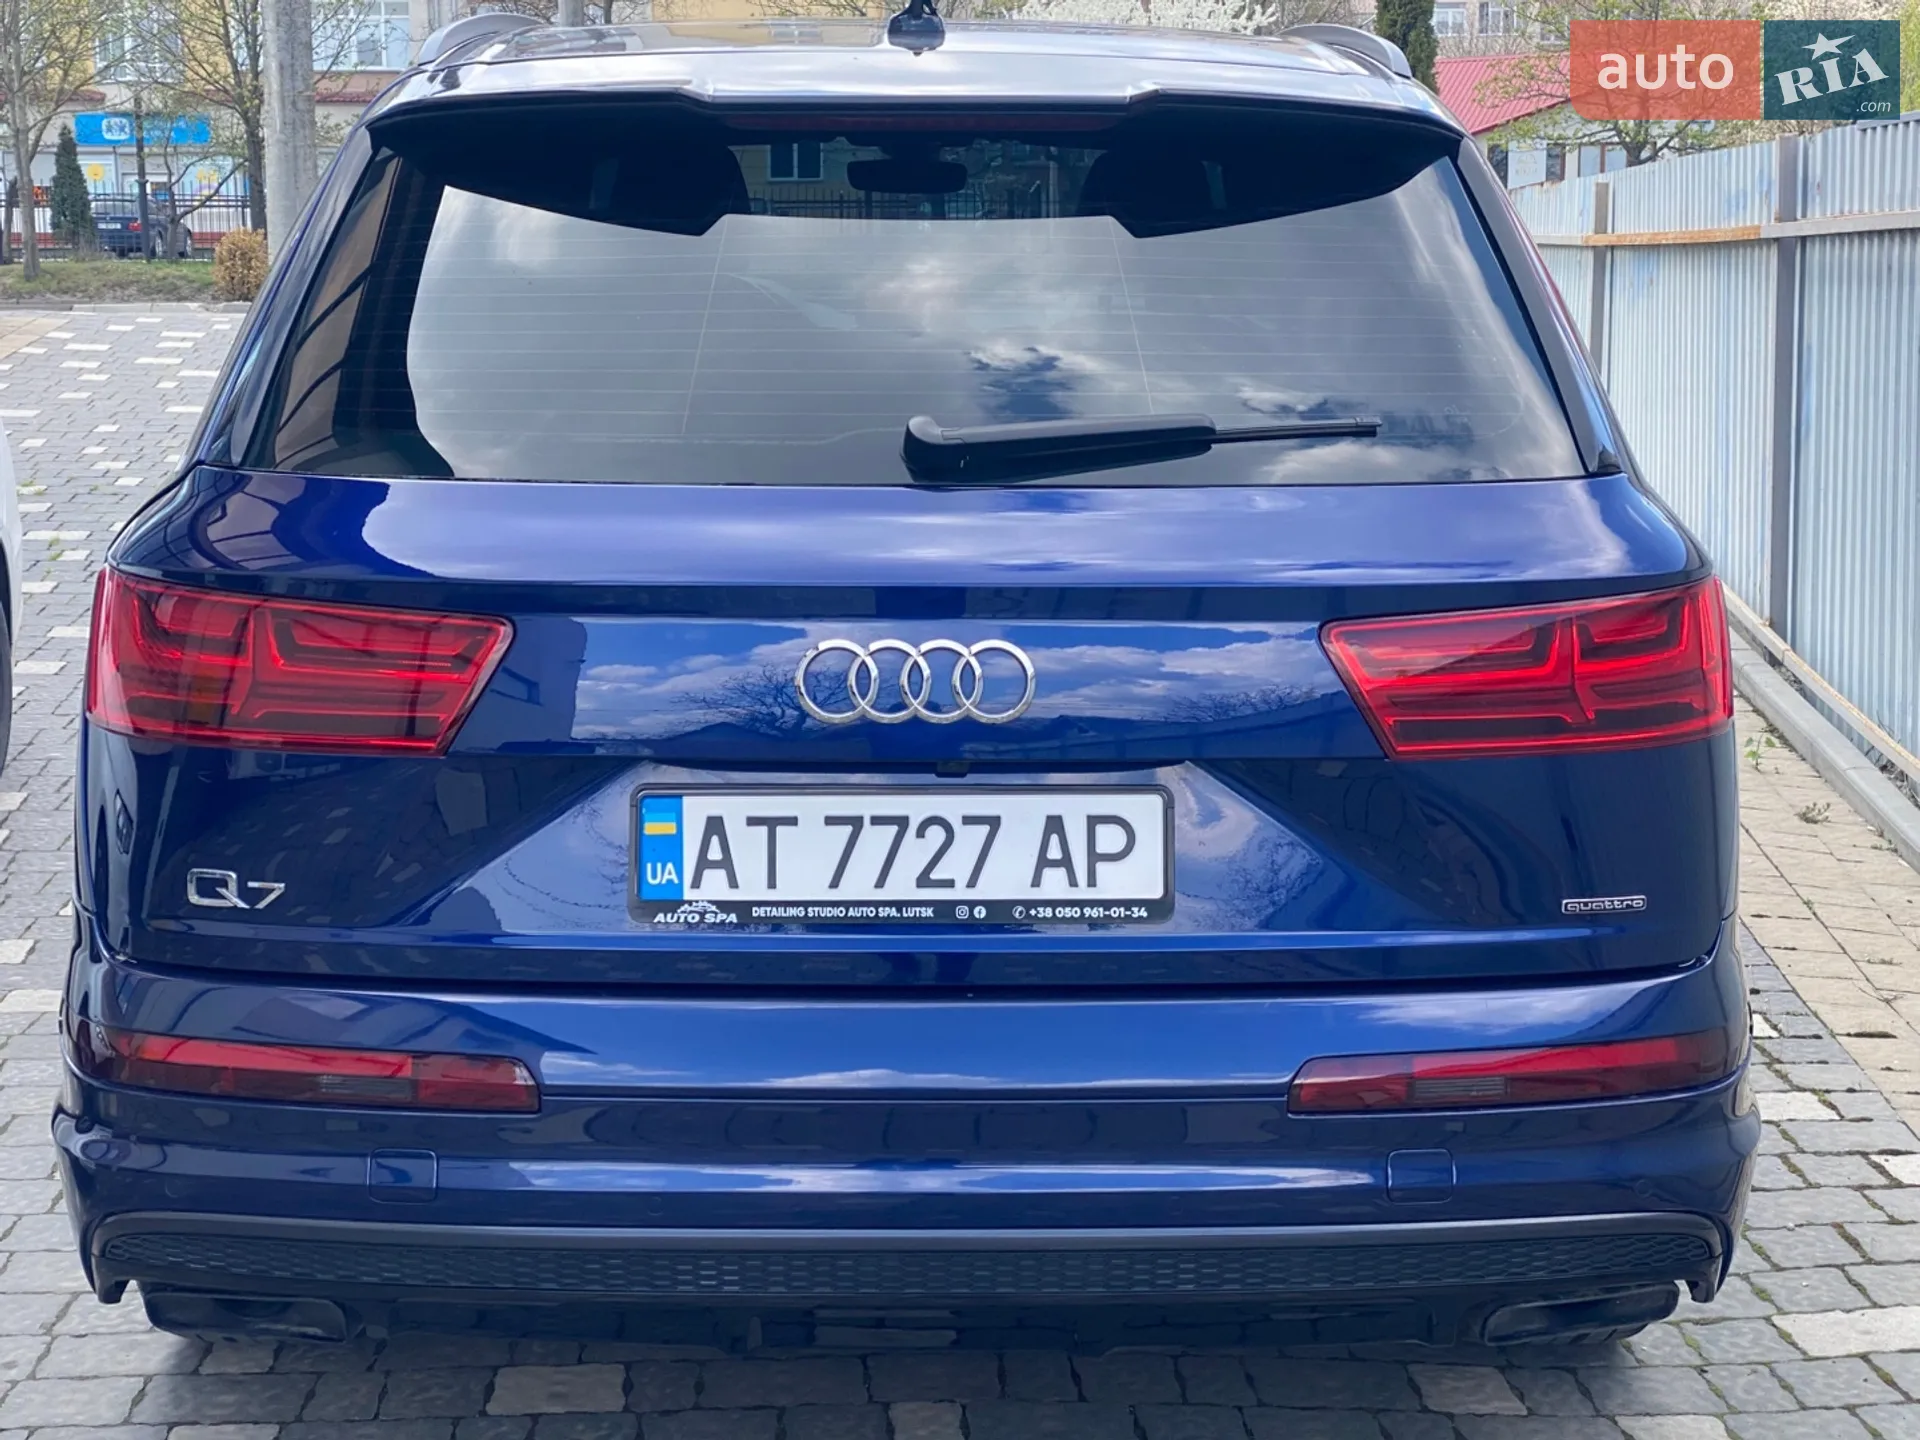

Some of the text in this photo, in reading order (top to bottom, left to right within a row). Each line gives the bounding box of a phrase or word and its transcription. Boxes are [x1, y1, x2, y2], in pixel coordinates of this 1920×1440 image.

[690, 814, 1137, 890] AT 7727 AP
[646, 862, 679, 885] UA
[187, 868, 286, 909] Q7
[752, 906, 934, 918] DETAILING STUDIO AUTO SPA. LUTSK
[1029, 906, 1149, 918] +38 050 961-01-34
[1567, 899, 1644, 913] quattro
[653, 912, 738, 923] AUTO SPA
